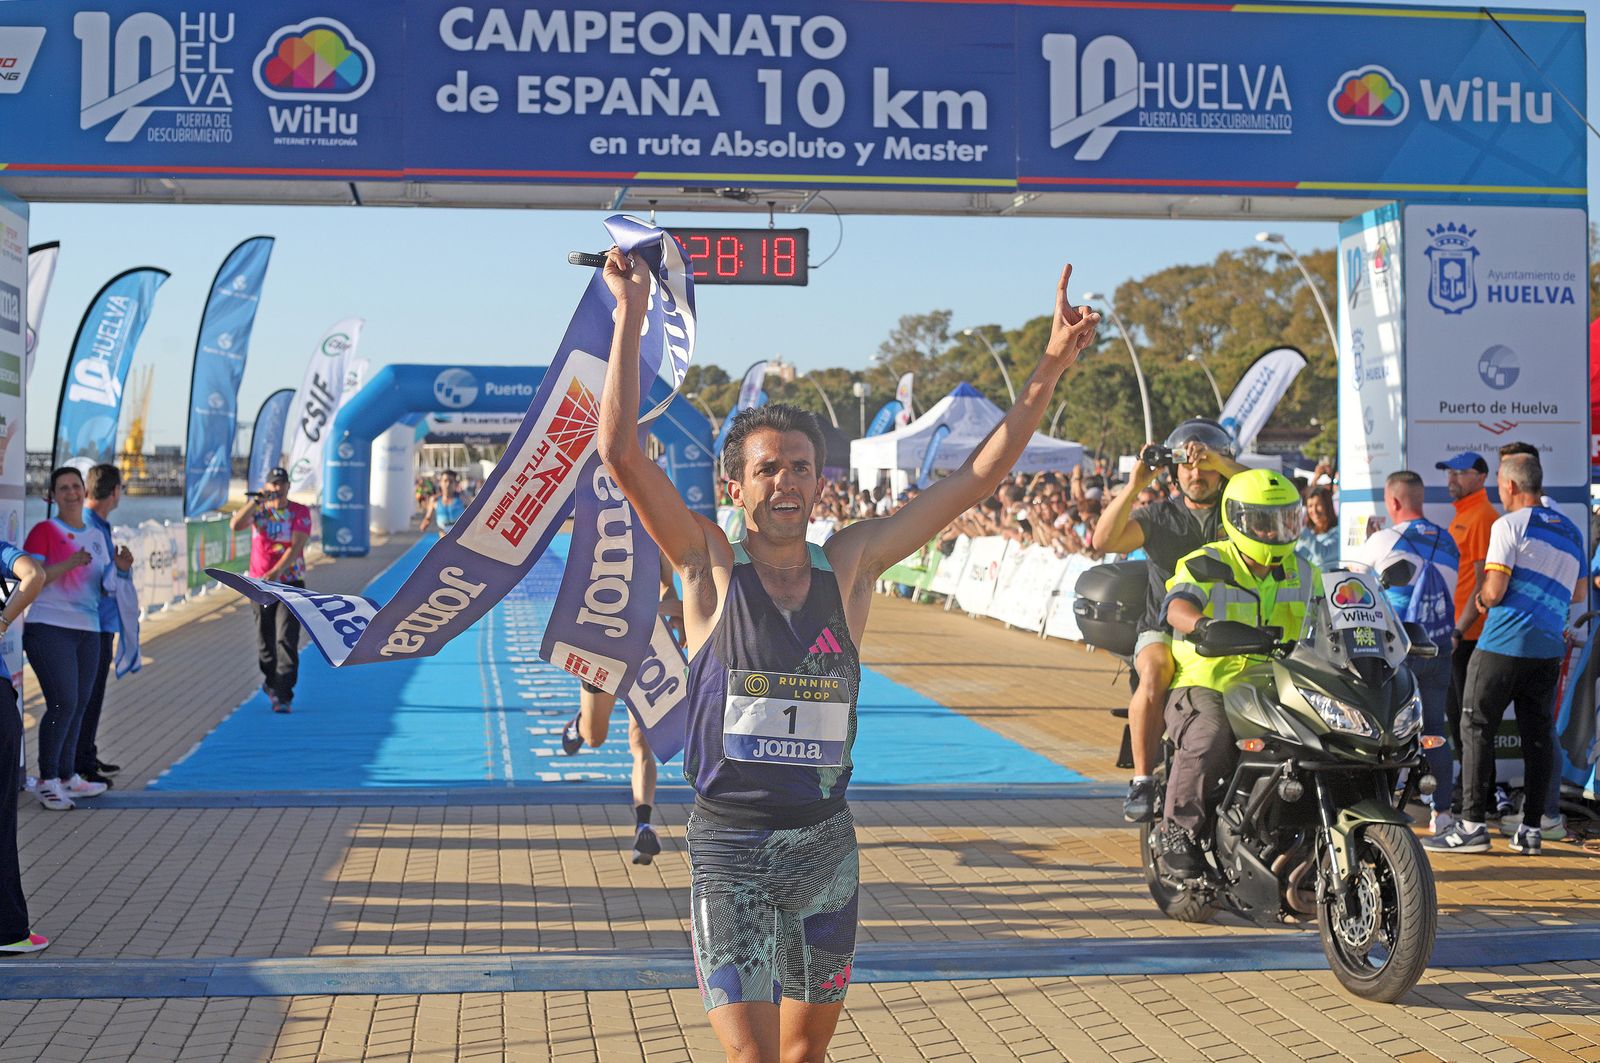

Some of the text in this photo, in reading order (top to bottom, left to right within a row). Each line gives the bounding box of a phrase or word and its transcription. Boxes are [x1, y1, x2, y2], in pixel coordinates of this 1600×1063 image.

[439, 6, 847, 60] CAMPEONATO
[435, 67, 988, 131] de ESPAÑA 10 km
[1139, 61, 1292, 111] HUELVA
[1419, 76, 1553, 124] WiHu
[176, 113, 232, 128] PUERTA DEL
[268, 104, 358, 134] WiHu
[1139, 112, 1292, 131] PUERTA DEL DESCUBRIMIENTO
[148, 127, 233, 143] DESCUBRIMIENTO
[274, 137, 310, 146] INTERNET
[311, 138, 317, 146] Y
[589, 131, 988, 166] en ruta Absoluto y Master
[690, 236, 796, 277] 28:18
[1488, 269, 1576, 284] Ayuntamiento de
[1487, 285, 1576, 304] HUELVA
[90, 296, 130, 361] HUELVA
[485, 382, 533, 396] Puerto
[302, 373, 335, 442] CSIF
[1439, 401, 1558, 415] Puerto de Huelva
[485, 440, 551, 530] ATLETISMO
[499, 450, 573, 549] RFEA
[575, 463, 634, 638] Joma
[380, 566, 487, 657] Joma
[1343, 610, 1376, 623] WiHu
[779, 677, 839, 689] RUNNING
[794, 691, 830, 700] LOOP
[783, 705, 798, 735] 1
[753, 738, 823, 760] Joma
